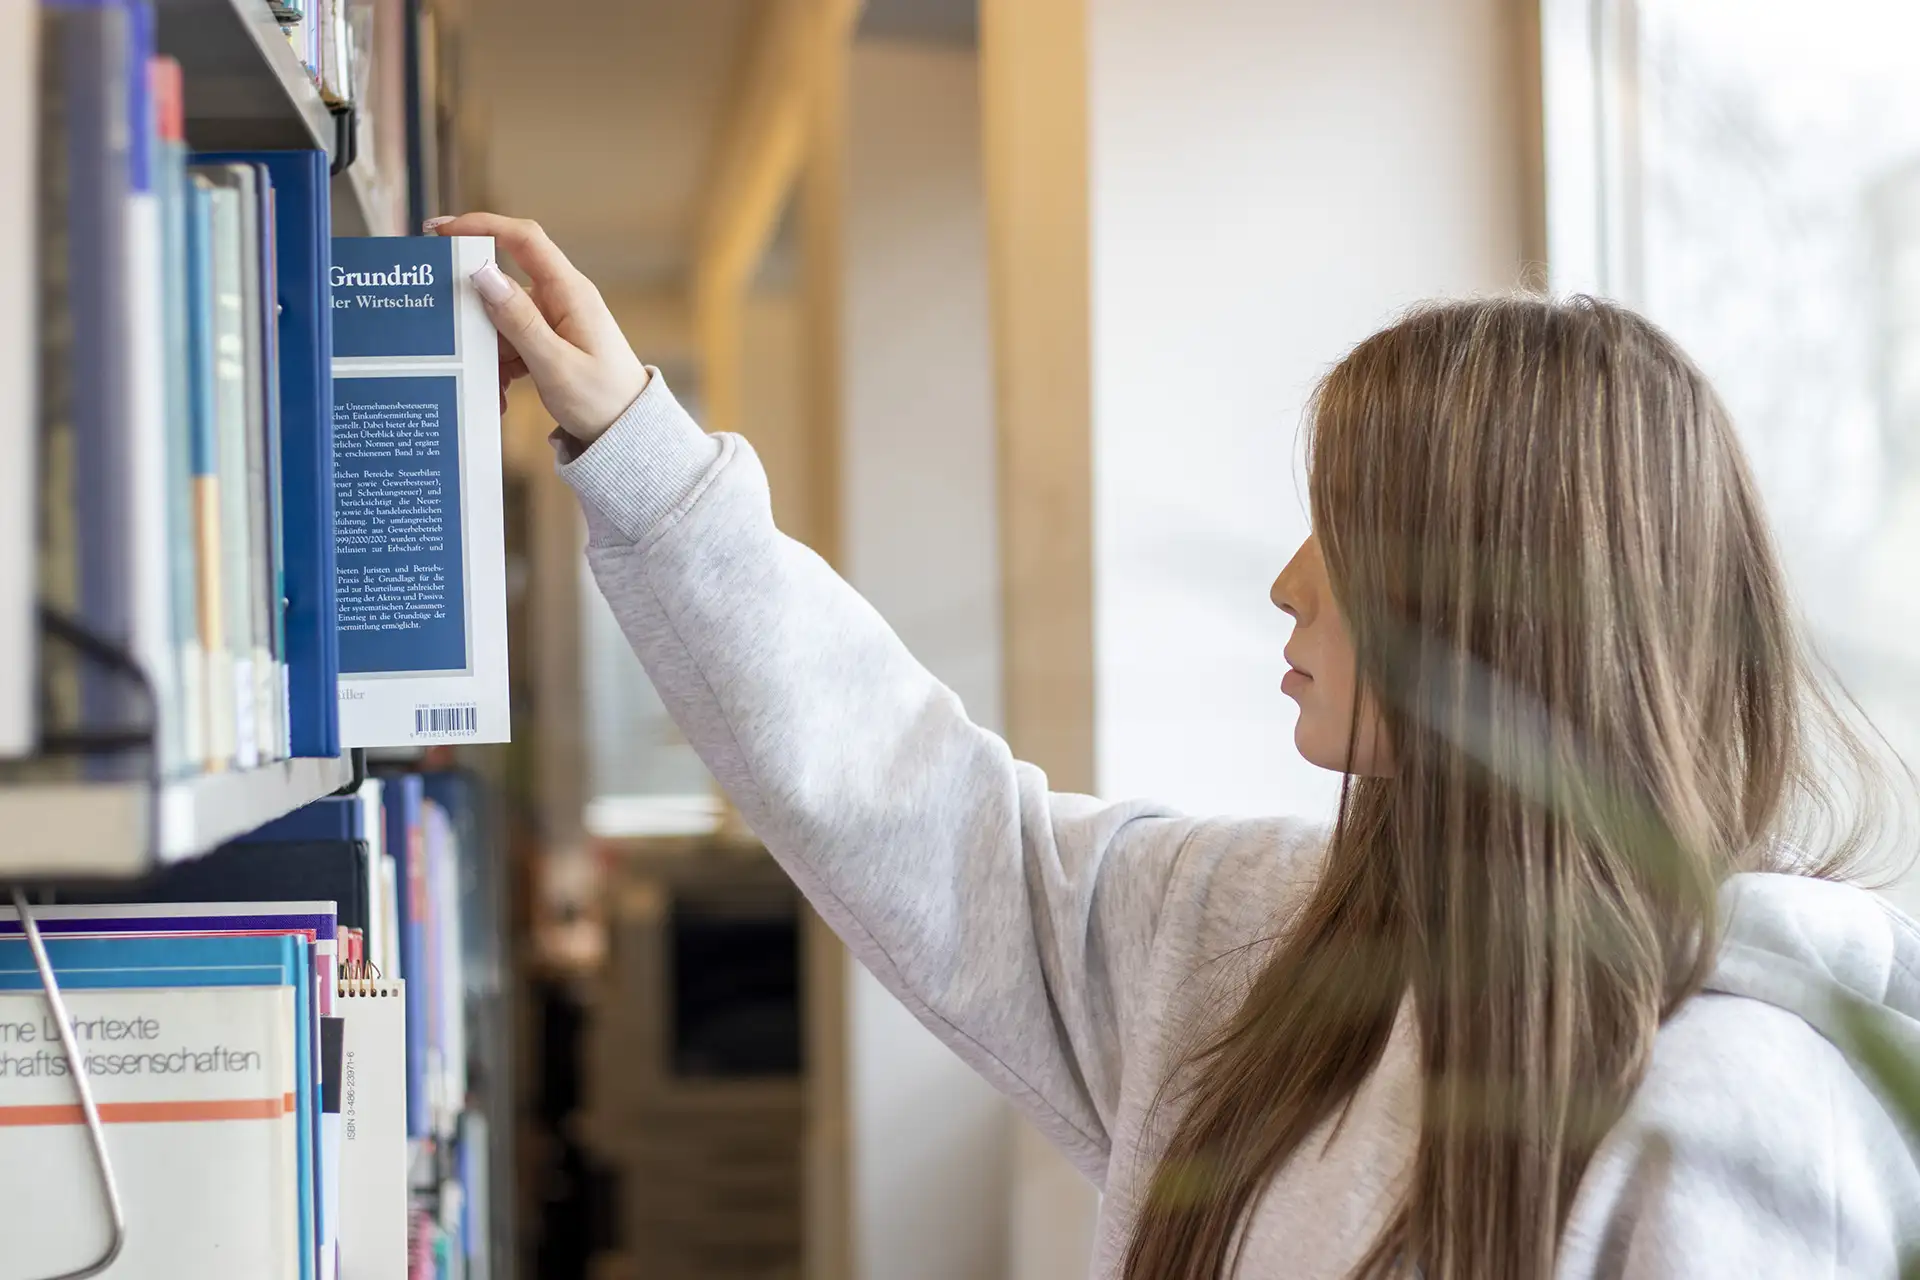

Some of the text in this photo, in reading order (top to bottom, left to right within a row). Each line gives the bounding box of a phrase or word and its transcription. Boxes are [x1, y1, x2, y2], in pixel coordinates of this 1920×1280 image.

[329, 264, 434, 287] Grundriß
[356, 294, 435, 308] Wirtschaft
[346, 402, 438, 411] Unternehmensbesteuerung
[361, 429, 394, 438] Überblick
[345, 449, 391, 457] erschienenen
[427, 448, 440, 456] den
[341, 498, 392, 506] berücksichtigt
[390, 515, 443, 524] umfangreichen
[388, 525, 443, 533] Gewerbebetrieb
[429, 543, 443, 551] und
[363, 566, 390, 575] Juristen
[338, 576, 359, 584] Praxis
[379, 575, 415, 583] Grundlage
[407, 583, 444, 591] zahlreicher
[377, 593, 401, 601] Aktiva
[352, 603, 403, 613] systematischen
[338, 613, 366, 621] Einstieg
[380, 612, 390, 620] die
[394, 611, 431, 620] Grundzüge
[43, 1015, 160, 1041] Lhrtexte
[0, 1045, 261, 1077] haftsissenschaften
[347, 1118, 356, 1141] ISBN
